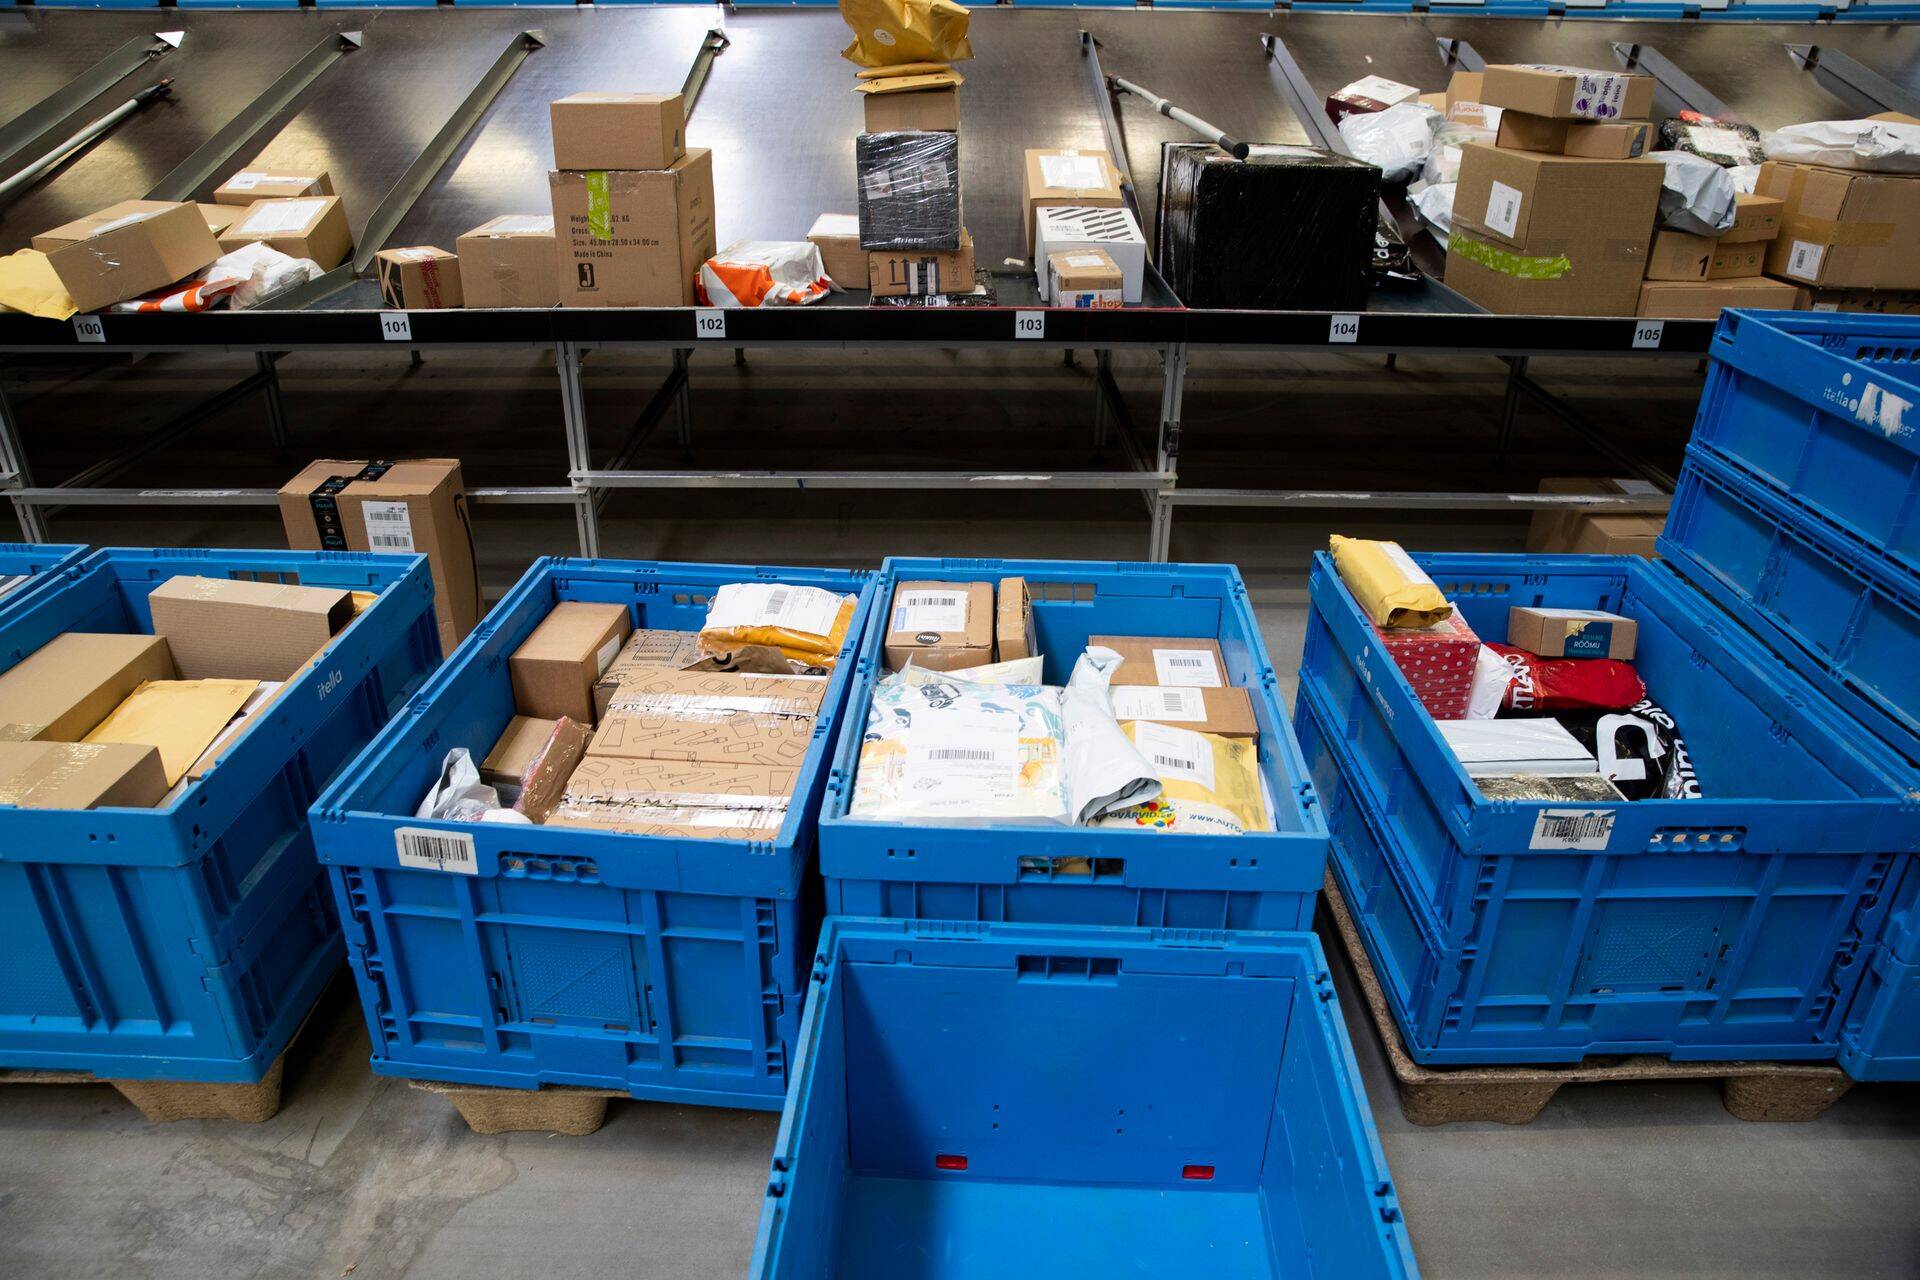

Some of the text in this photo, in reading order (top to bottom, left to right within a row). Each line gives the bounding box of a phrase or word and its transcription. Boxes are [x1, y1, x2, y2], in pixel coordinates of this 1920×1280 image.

[1699, 255, 1710, 276] 1
[77, 323, 101, 335] 100
[384, 321, 408, 333] 101
[700, 318, 723, 330] 102
[1019, 319, 1042, 331] 103
[1333, 323, 1357, 335] 104
[1637, 329, 1660, 341] 105
[318, 669, 343, 701] itella
